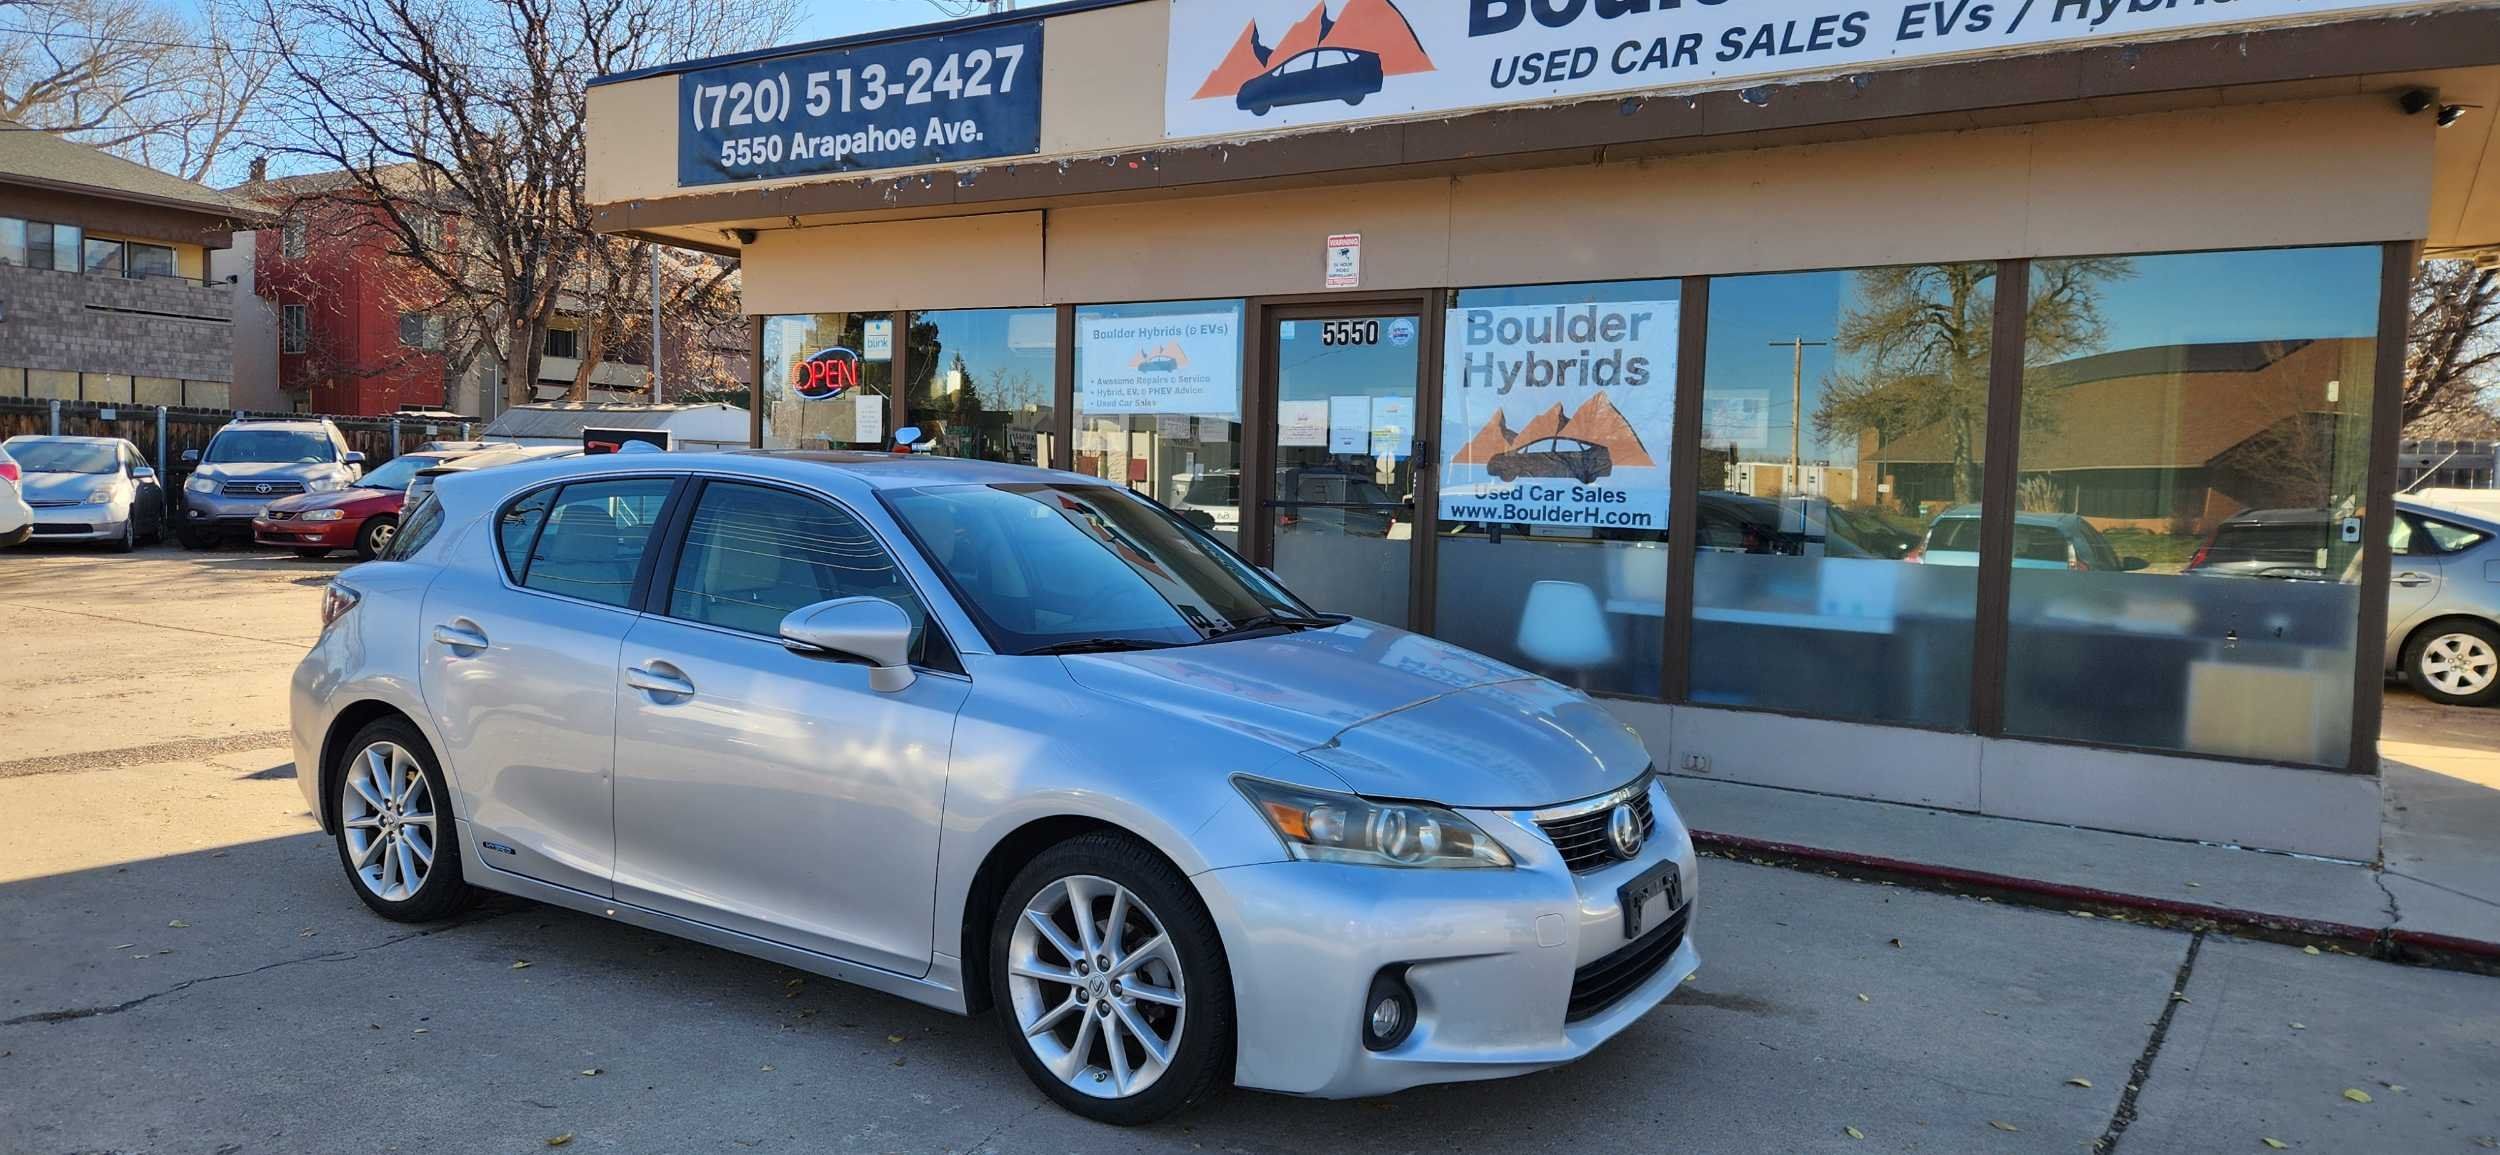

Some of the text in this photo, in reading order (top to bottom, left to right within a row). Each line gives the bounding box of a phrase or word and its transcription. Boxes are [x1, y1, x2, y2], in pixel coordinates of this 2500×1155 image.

[1490, 46, 1598, 88] USED
[1611, 32, 1703, 75] CAR
[1715, 11, 1870, 62] SALES
[1896, 0, 1994, 41] EVs
[693, 44, 1025, 131] (720) 513-2427
[721, 117, 984, 167] 5550 Arapahoe Ave.
[1093, 328, 1135, 340] Boulder
[1138, 326, 1182, 340] Hybrids
[1322, 320, 1380, 346] 5550
[1466, 305, 1653, 346] Boulder
[791, 359, 857, 390] OPEN
[1463, 349, 1651, 395] Hybrids
[1474, 484, 1627, 503] Used Car Sales
[1451, 503, 1651, 526] www.BoulderH.com
